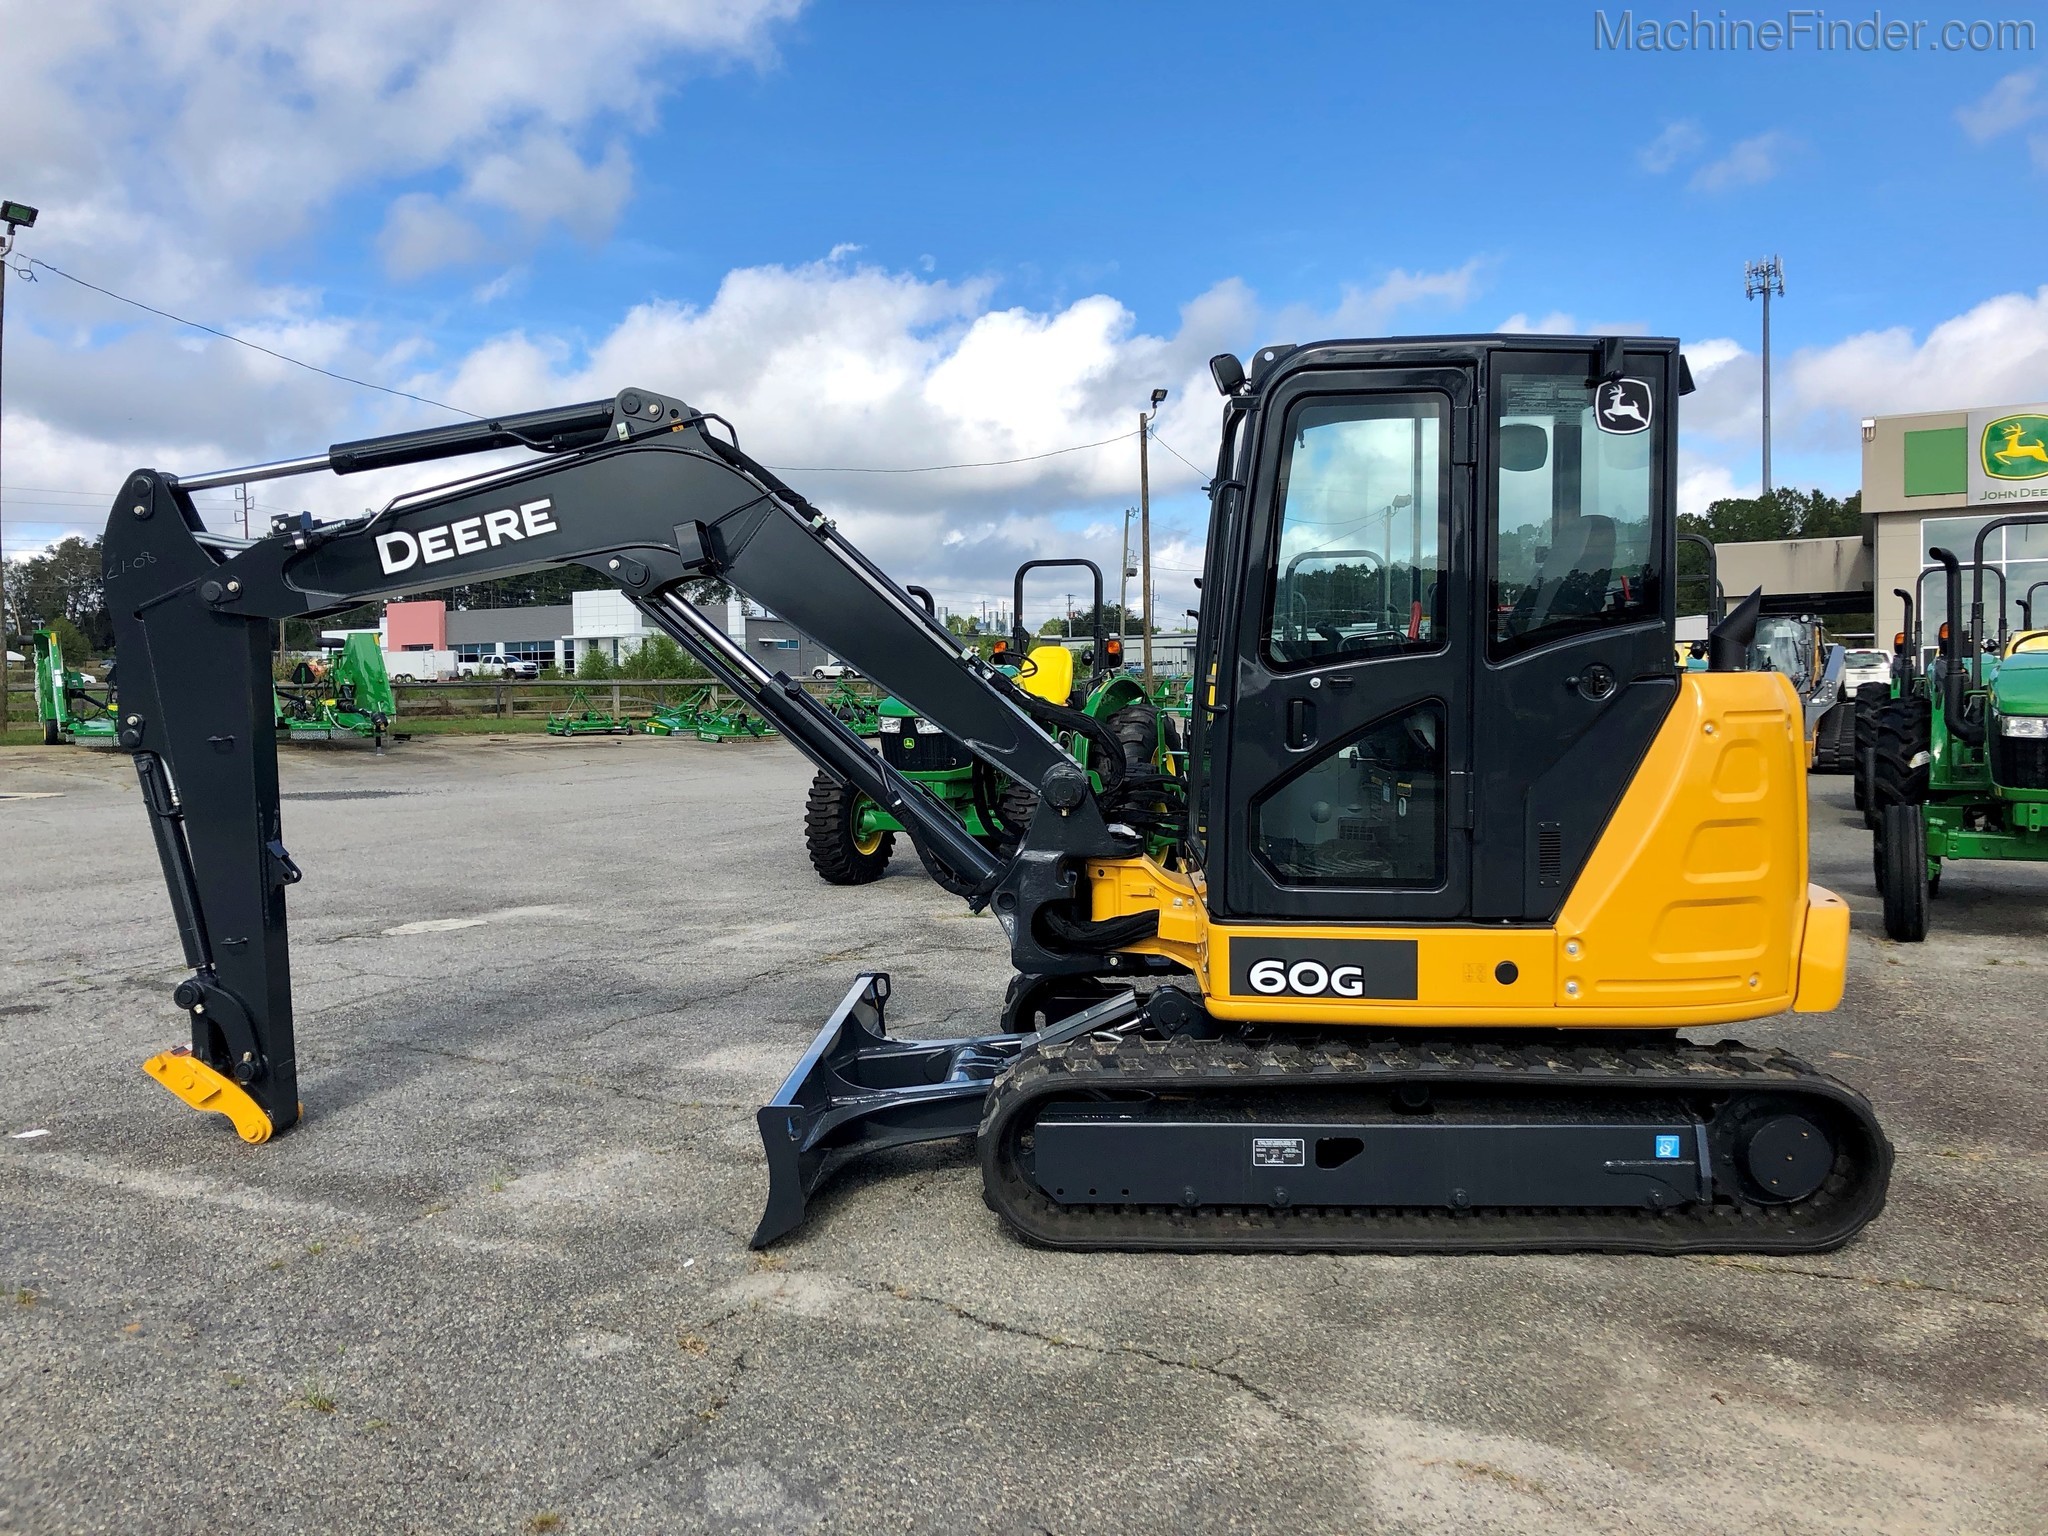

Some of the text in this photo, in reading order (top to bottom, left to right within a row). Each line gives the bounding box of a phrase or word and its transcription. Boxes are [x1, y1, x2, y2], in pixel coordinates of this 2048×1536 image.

[1980, 490, 2018, 501] JOHN
[375, 498, 557, 575] DEERE
[1248, 959, 1364, 997] 60G
